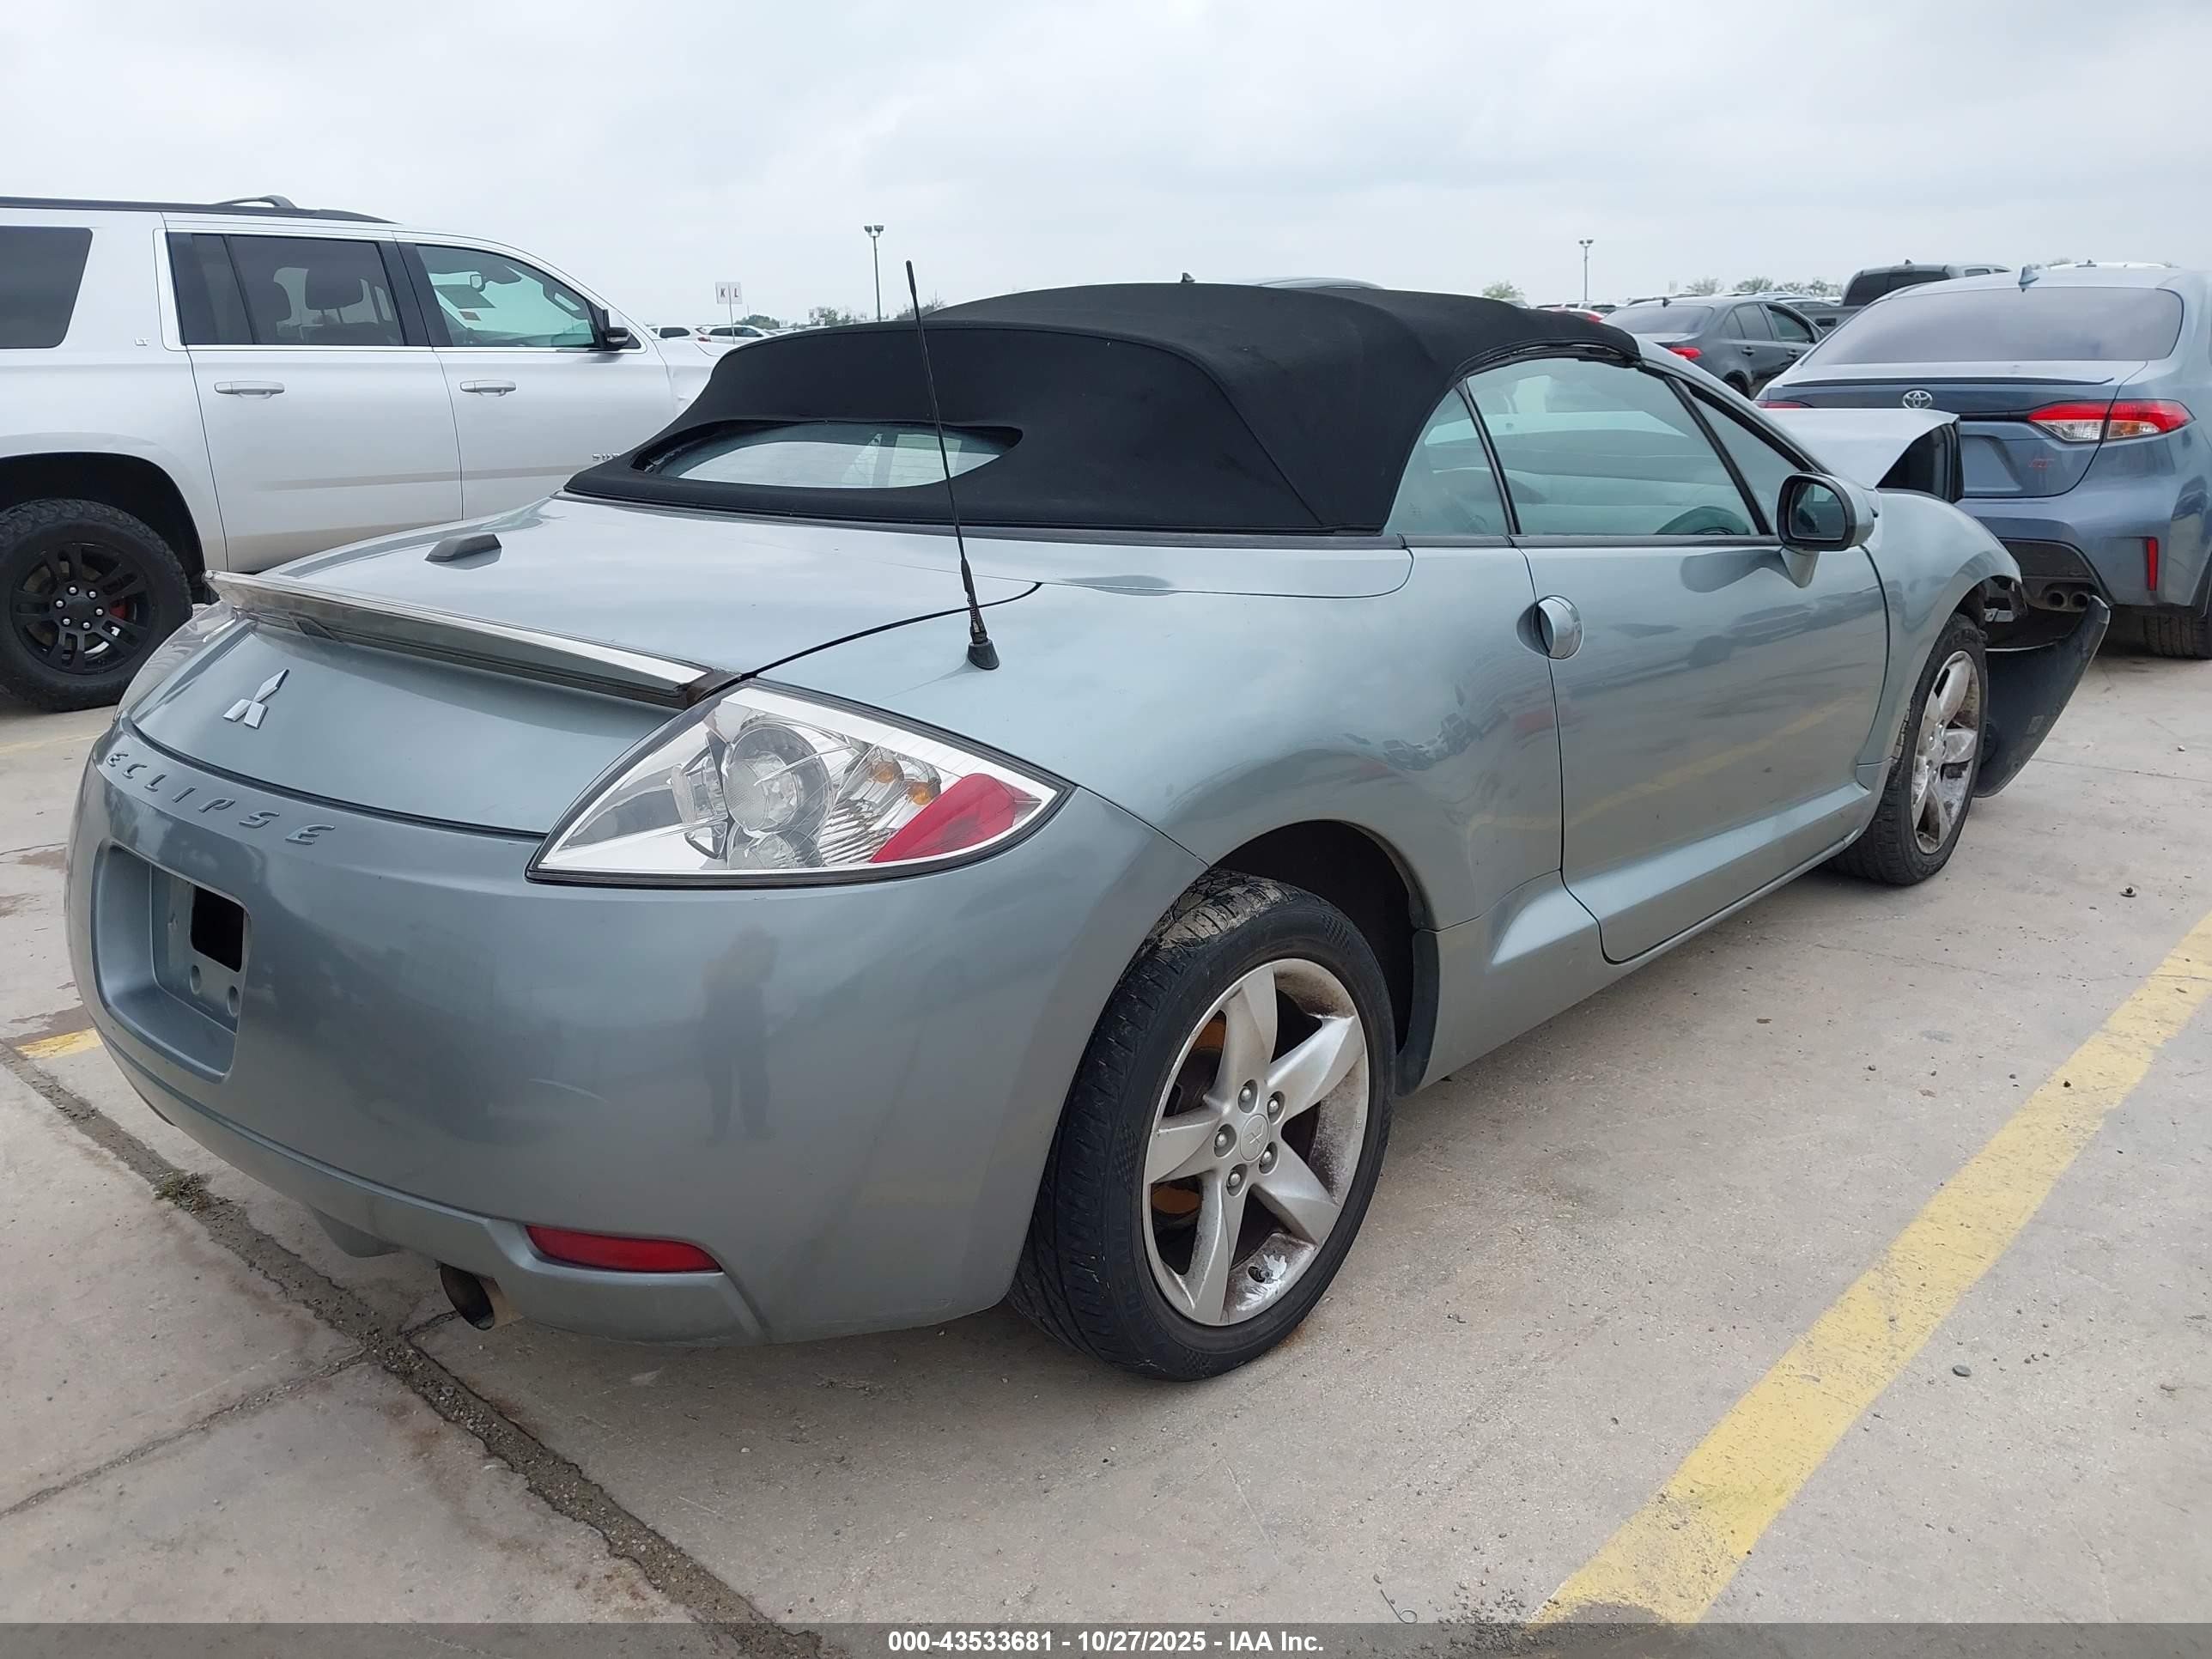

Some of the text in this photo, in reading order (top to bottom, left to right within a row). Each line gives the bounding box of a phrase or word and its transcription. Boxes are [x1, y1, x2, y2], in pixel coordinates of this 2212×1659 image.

[720, 288, 739, 298] K L
[105, 751, 336, 846] ECLIPSE
